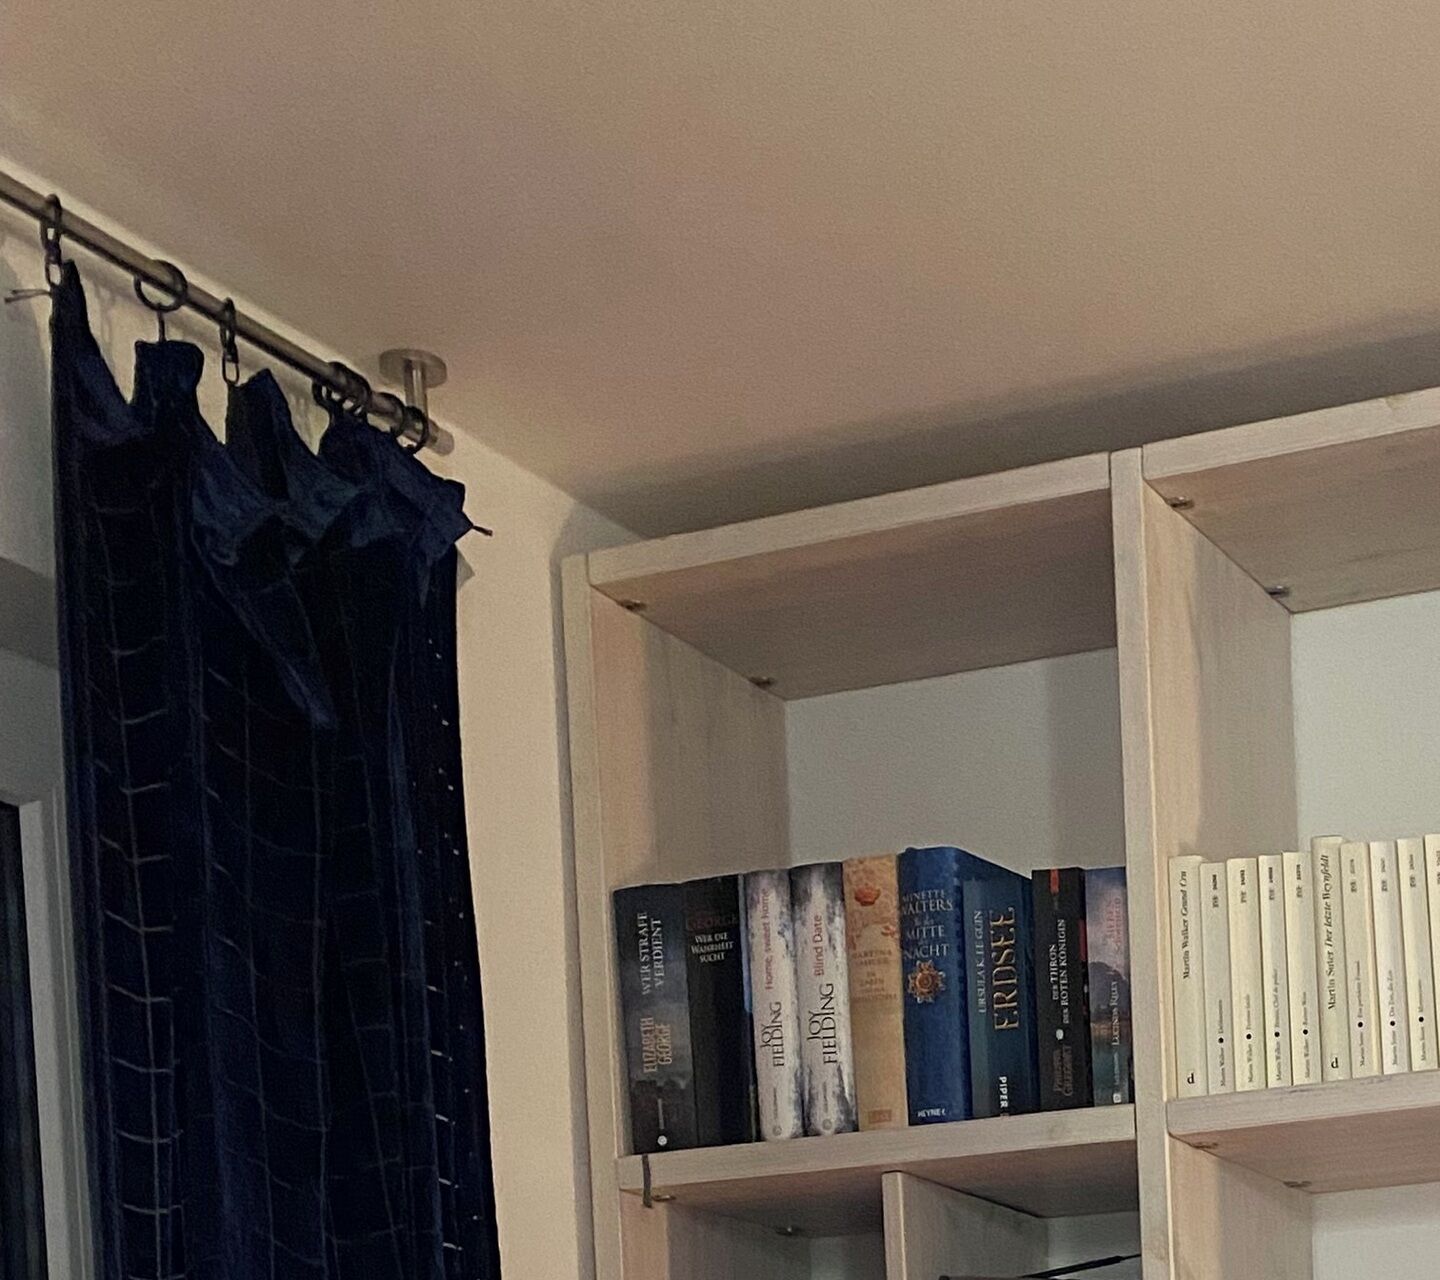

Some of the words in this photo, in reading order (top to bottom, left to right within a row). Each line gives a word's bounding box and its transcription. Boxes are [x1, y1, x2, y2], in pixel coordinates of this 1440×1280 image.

[637, 911, 650, 962] STRAFE
[812, 915, 822, 943] Date
[973, 910, 983, 940] GUIN
[650, 918, 665, 986] VERDIENT
[813, 946, 824, 975] Blind
[991, 907, 1020, 1030] ERDSEE
[641, 965, 652, 995] WER
[976, 969, 987, 1013] URSULA
[655, 1023, 673, 1065] GEORGE
[761, 1024, 773, 1048] JOY
[768, 1002, 785, 1067] FIELDING
[807, 1011, 821, 1040] JOY
[818, 983, 837, 1063] FIELDING
[640, 1017, 657, 1072] ELIZABETH
[999, 1077, 1008, 1108] PIPER
